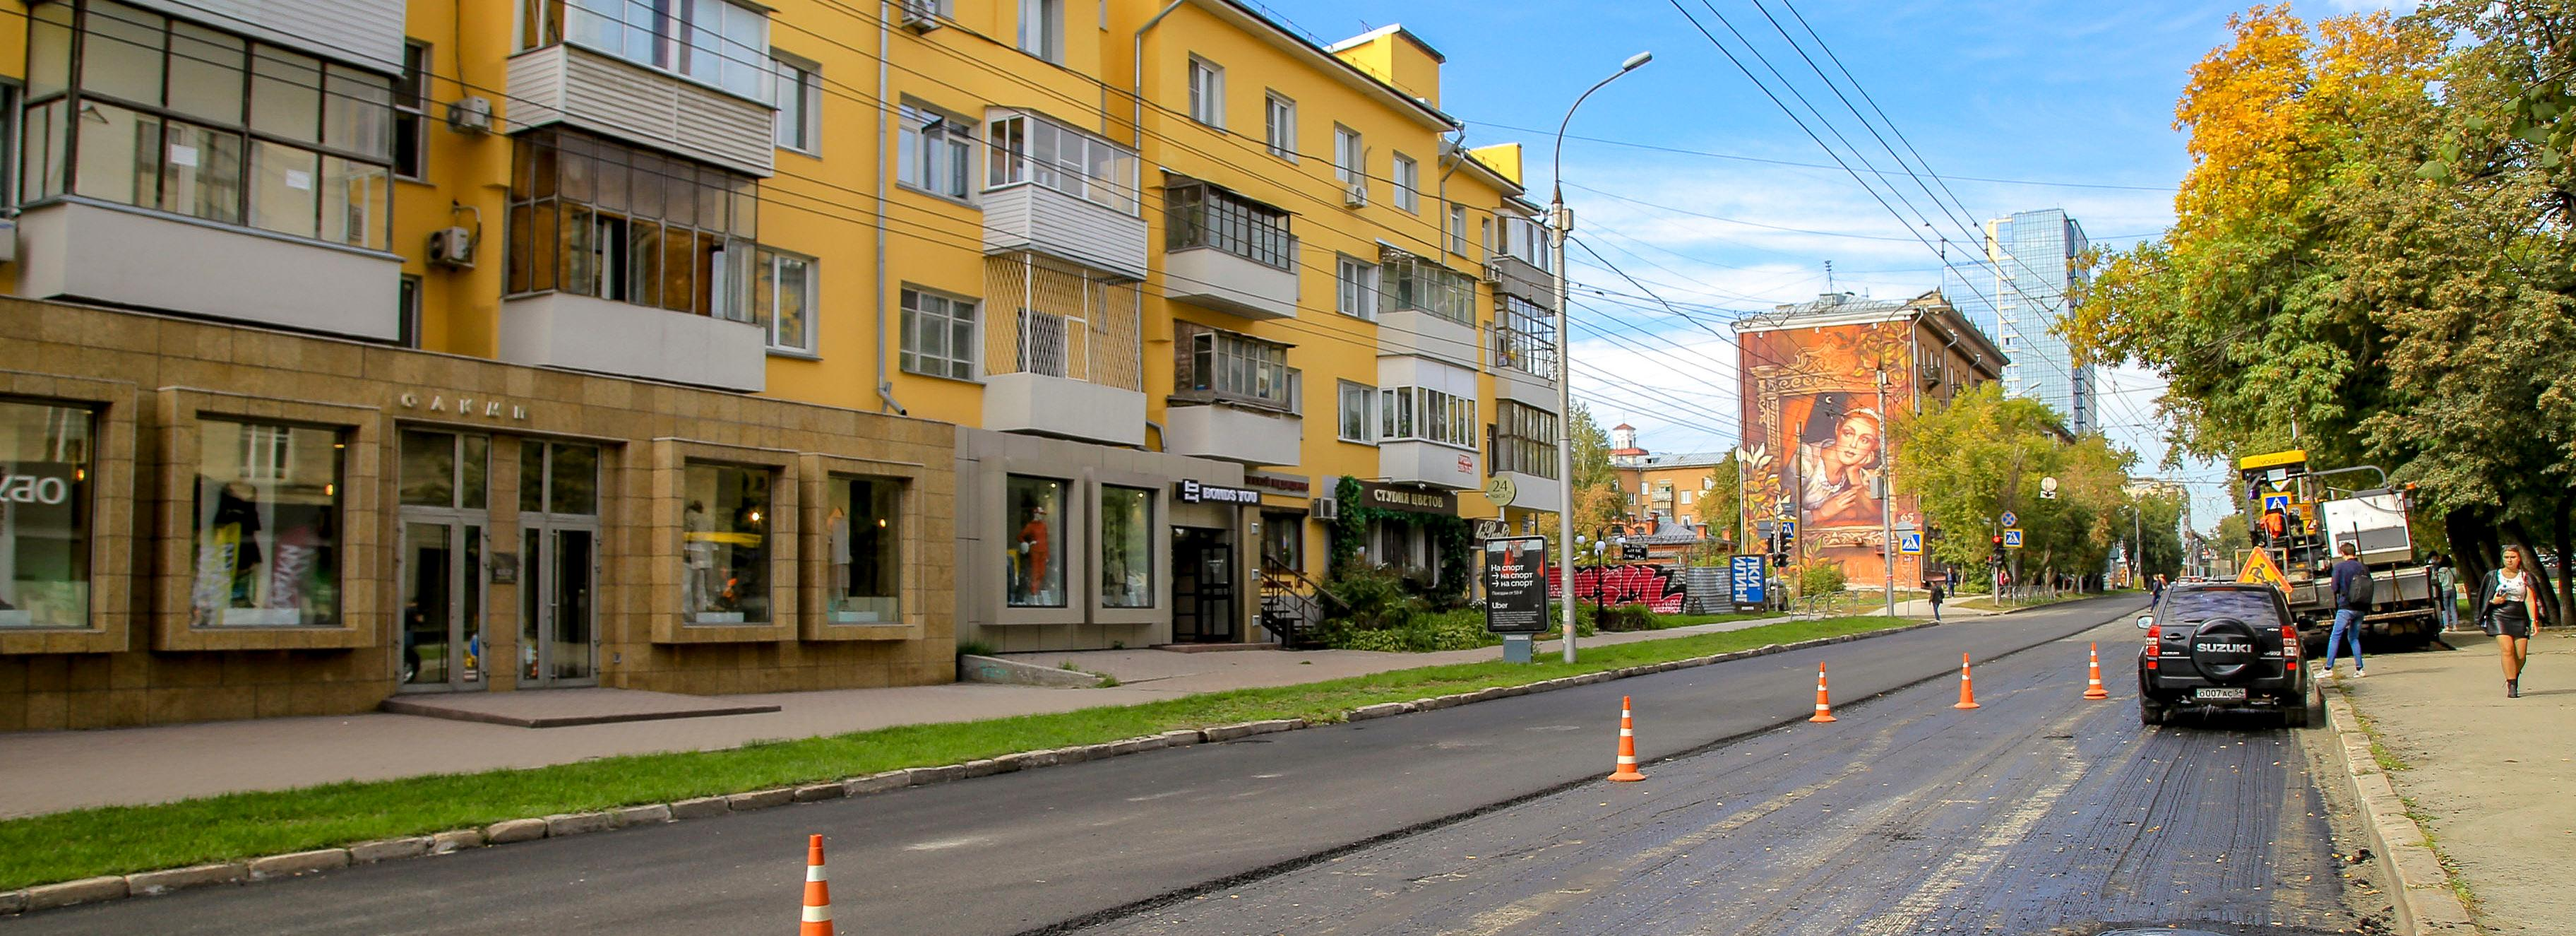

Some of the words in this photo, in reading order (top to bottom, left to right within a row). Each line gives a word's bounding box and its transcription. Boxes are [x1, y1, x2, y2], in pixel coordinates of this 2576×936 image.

[1492, 480, 1508, 492] 24
[1203, 487, 1236, 502] BONDS
[1237, 491, 1258, 503] YOU
[1373, 489, 1409, 504] СТУДИЯ
[1412, 494, 1443, 508] ЦВЕТОВ
[1900, 513, 1914, 522] 65
[1502, 564, 1524, 573] спорт
[1510, 572, 1533, 581] спорт
[1510, 580, 1533, 588] спорт
[2197, 643, 2251, 653] SUZUKI
